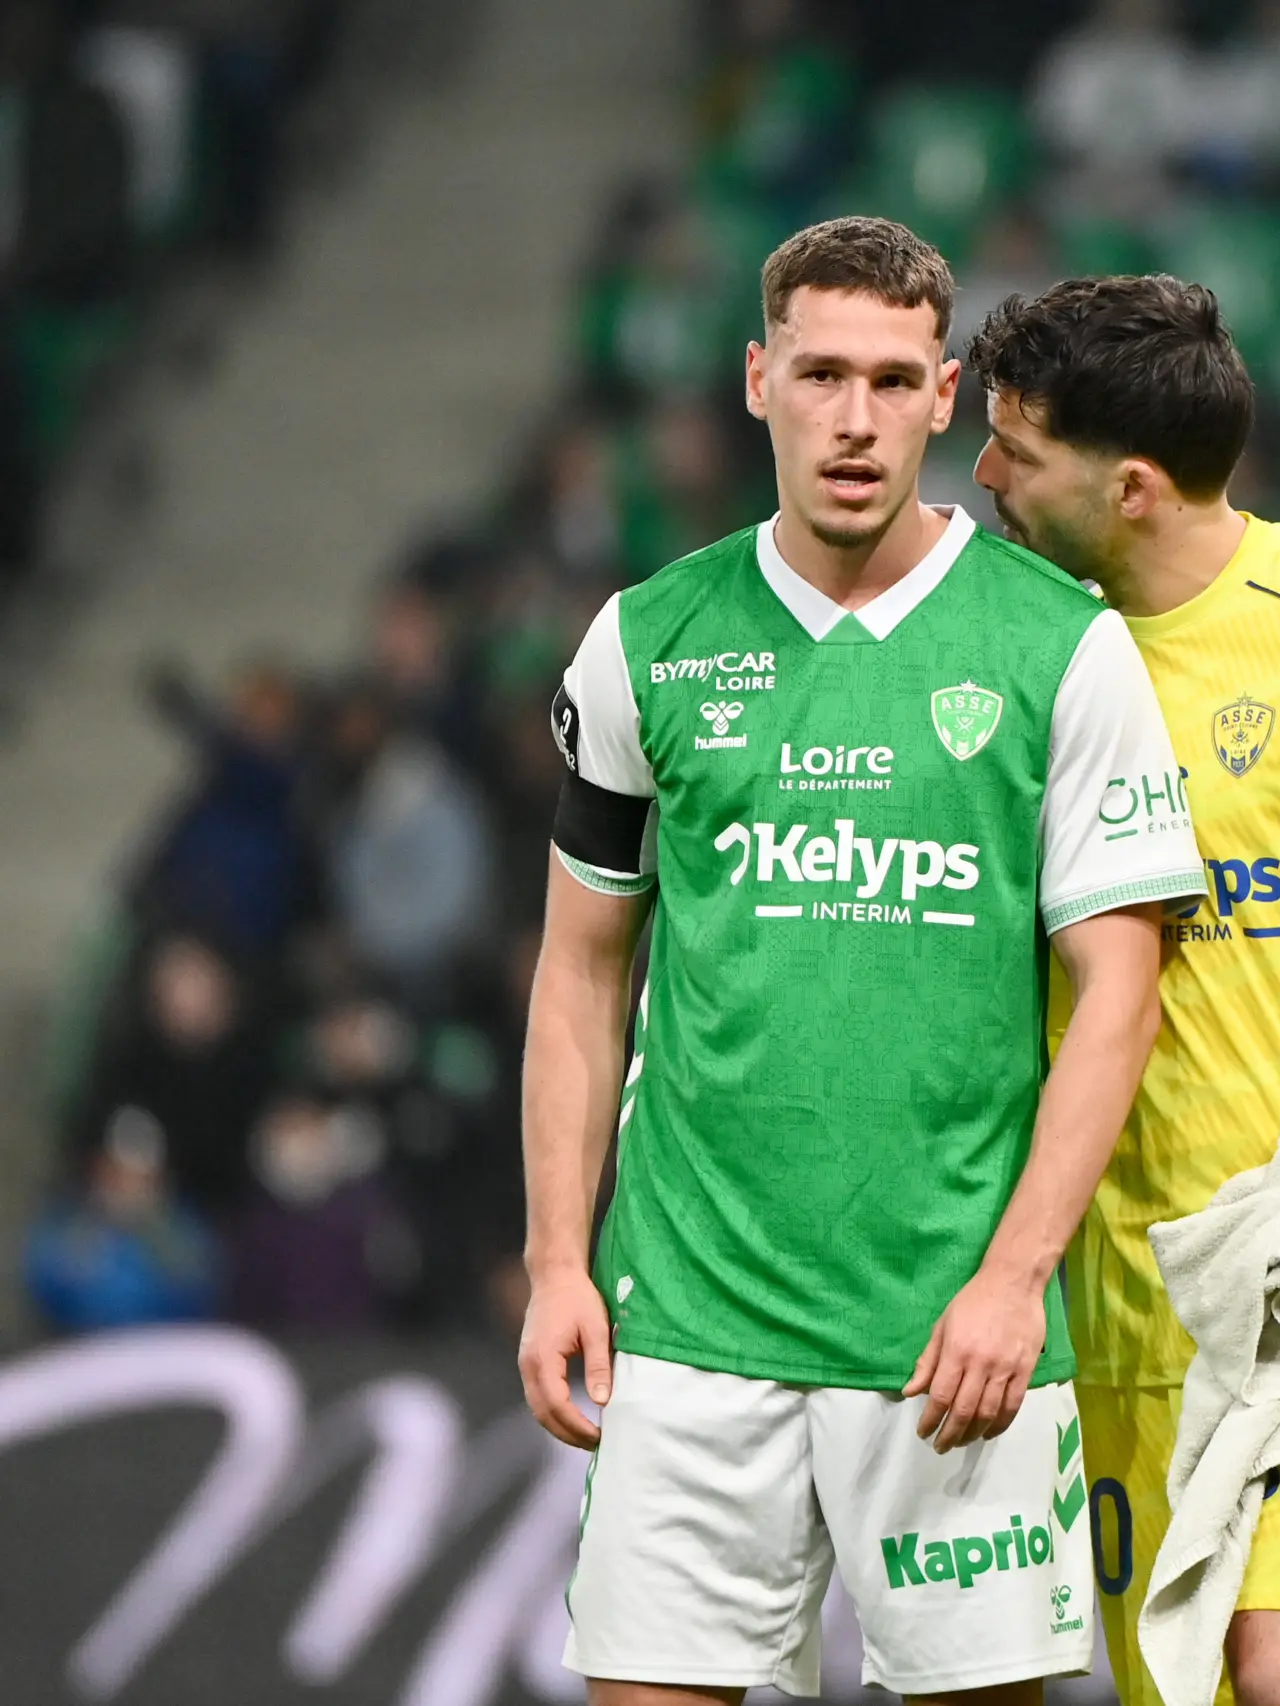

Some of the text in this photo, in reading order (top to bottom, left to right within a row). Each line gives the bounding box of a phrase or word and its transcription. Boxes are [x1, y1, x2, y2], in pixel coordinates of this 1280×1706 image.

[715, 676, 775, 691] LOIRE
[941, 694, 995, 715] ASSE
[1220, 708, 1266, 728] ASSE
[694, 733, 747, 750] hummel
[780, 742, 894, 775] Loire
[779, 778, 892, 791] LE DÉPARTEMENT
[753, 818, 980, 901] Kelyps
[812, 901, 912, 925] INTERIM
